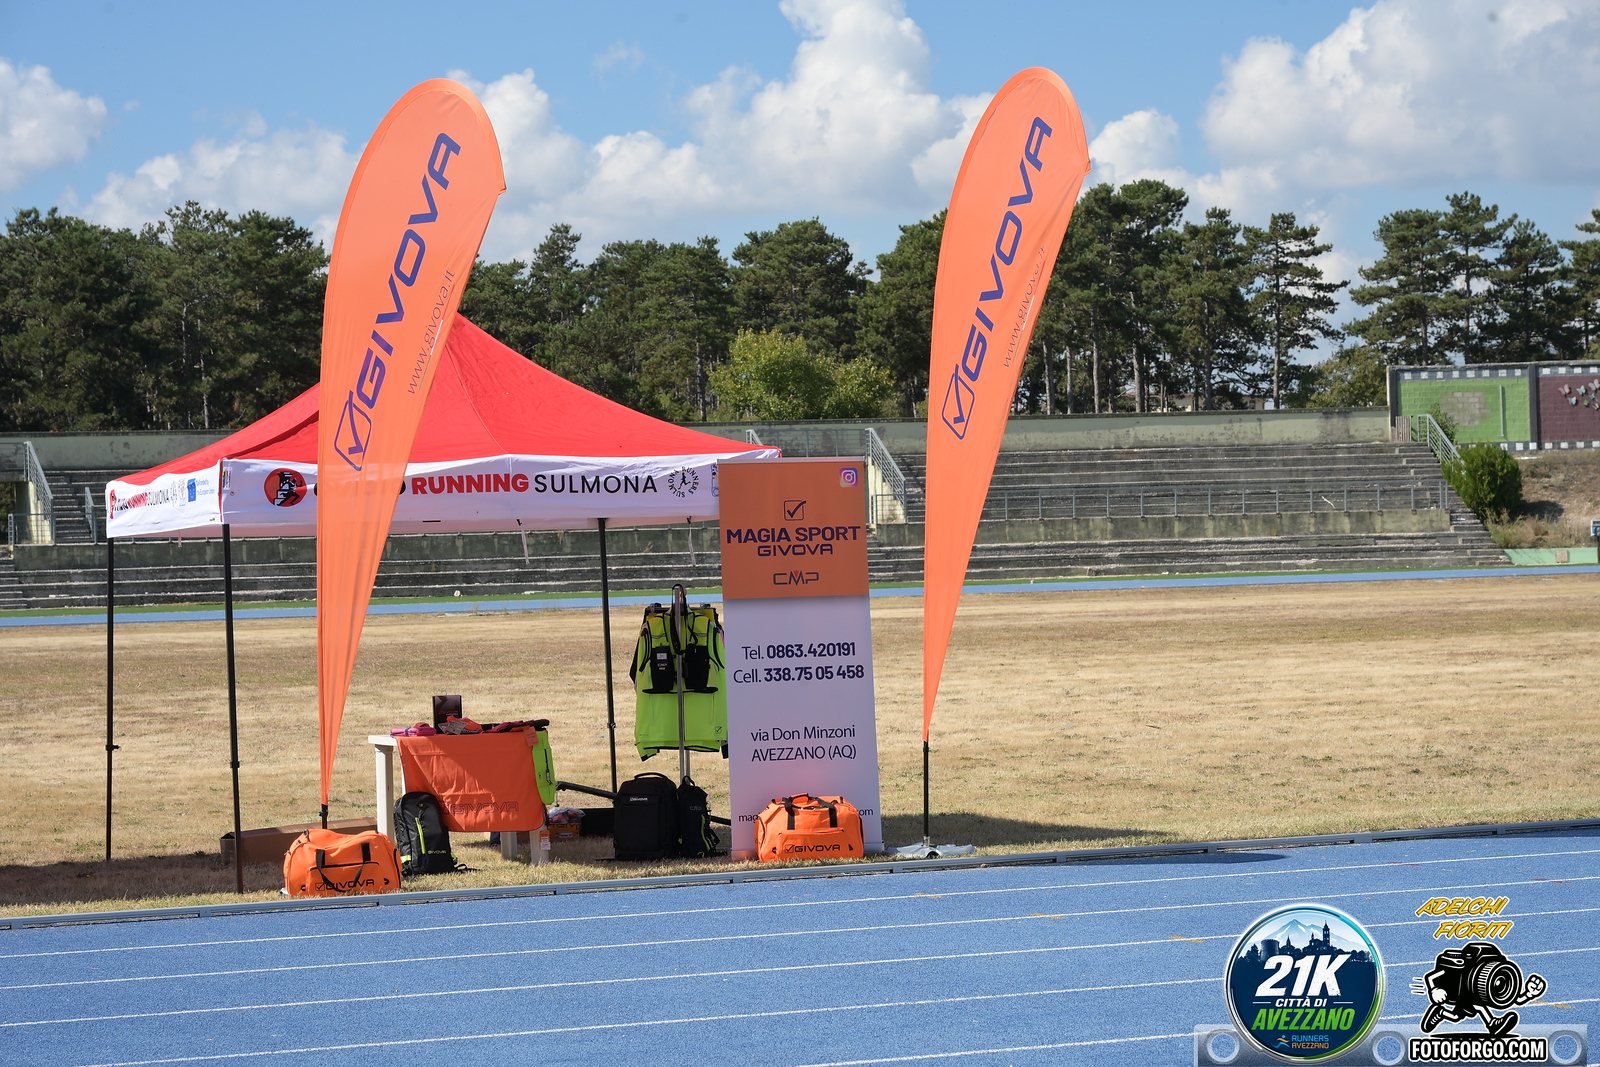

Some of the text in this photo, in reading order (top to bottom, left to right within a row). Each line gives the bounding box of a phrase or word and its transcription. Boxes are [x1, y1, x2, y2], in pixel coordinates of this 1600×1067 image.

[961, 116, 1053, 382] GIVOVA
[356, 132, 461, 410] GIVOVA
[408, 270, 455, 394] www.givova.it
[411, 473, 529, 495] RUNNING
[534, 474, 658, 494] SULMONA
[726, 526, 861, 544] MAGIA SPORT
[757, 543, 834, 557] GIVOVA
[773, 570, 819, 586] CMP
[741, 642, 856, 660] Tel. 0863.420191
[733, 664, 865, 684] Cell. 338.75 05 458
[751, 724, 856, 742] via Don Minzoni
[751, 744, 857, 762] AVEZZANO (AQ)
[795, 844, 841, 853] GIVOVA
